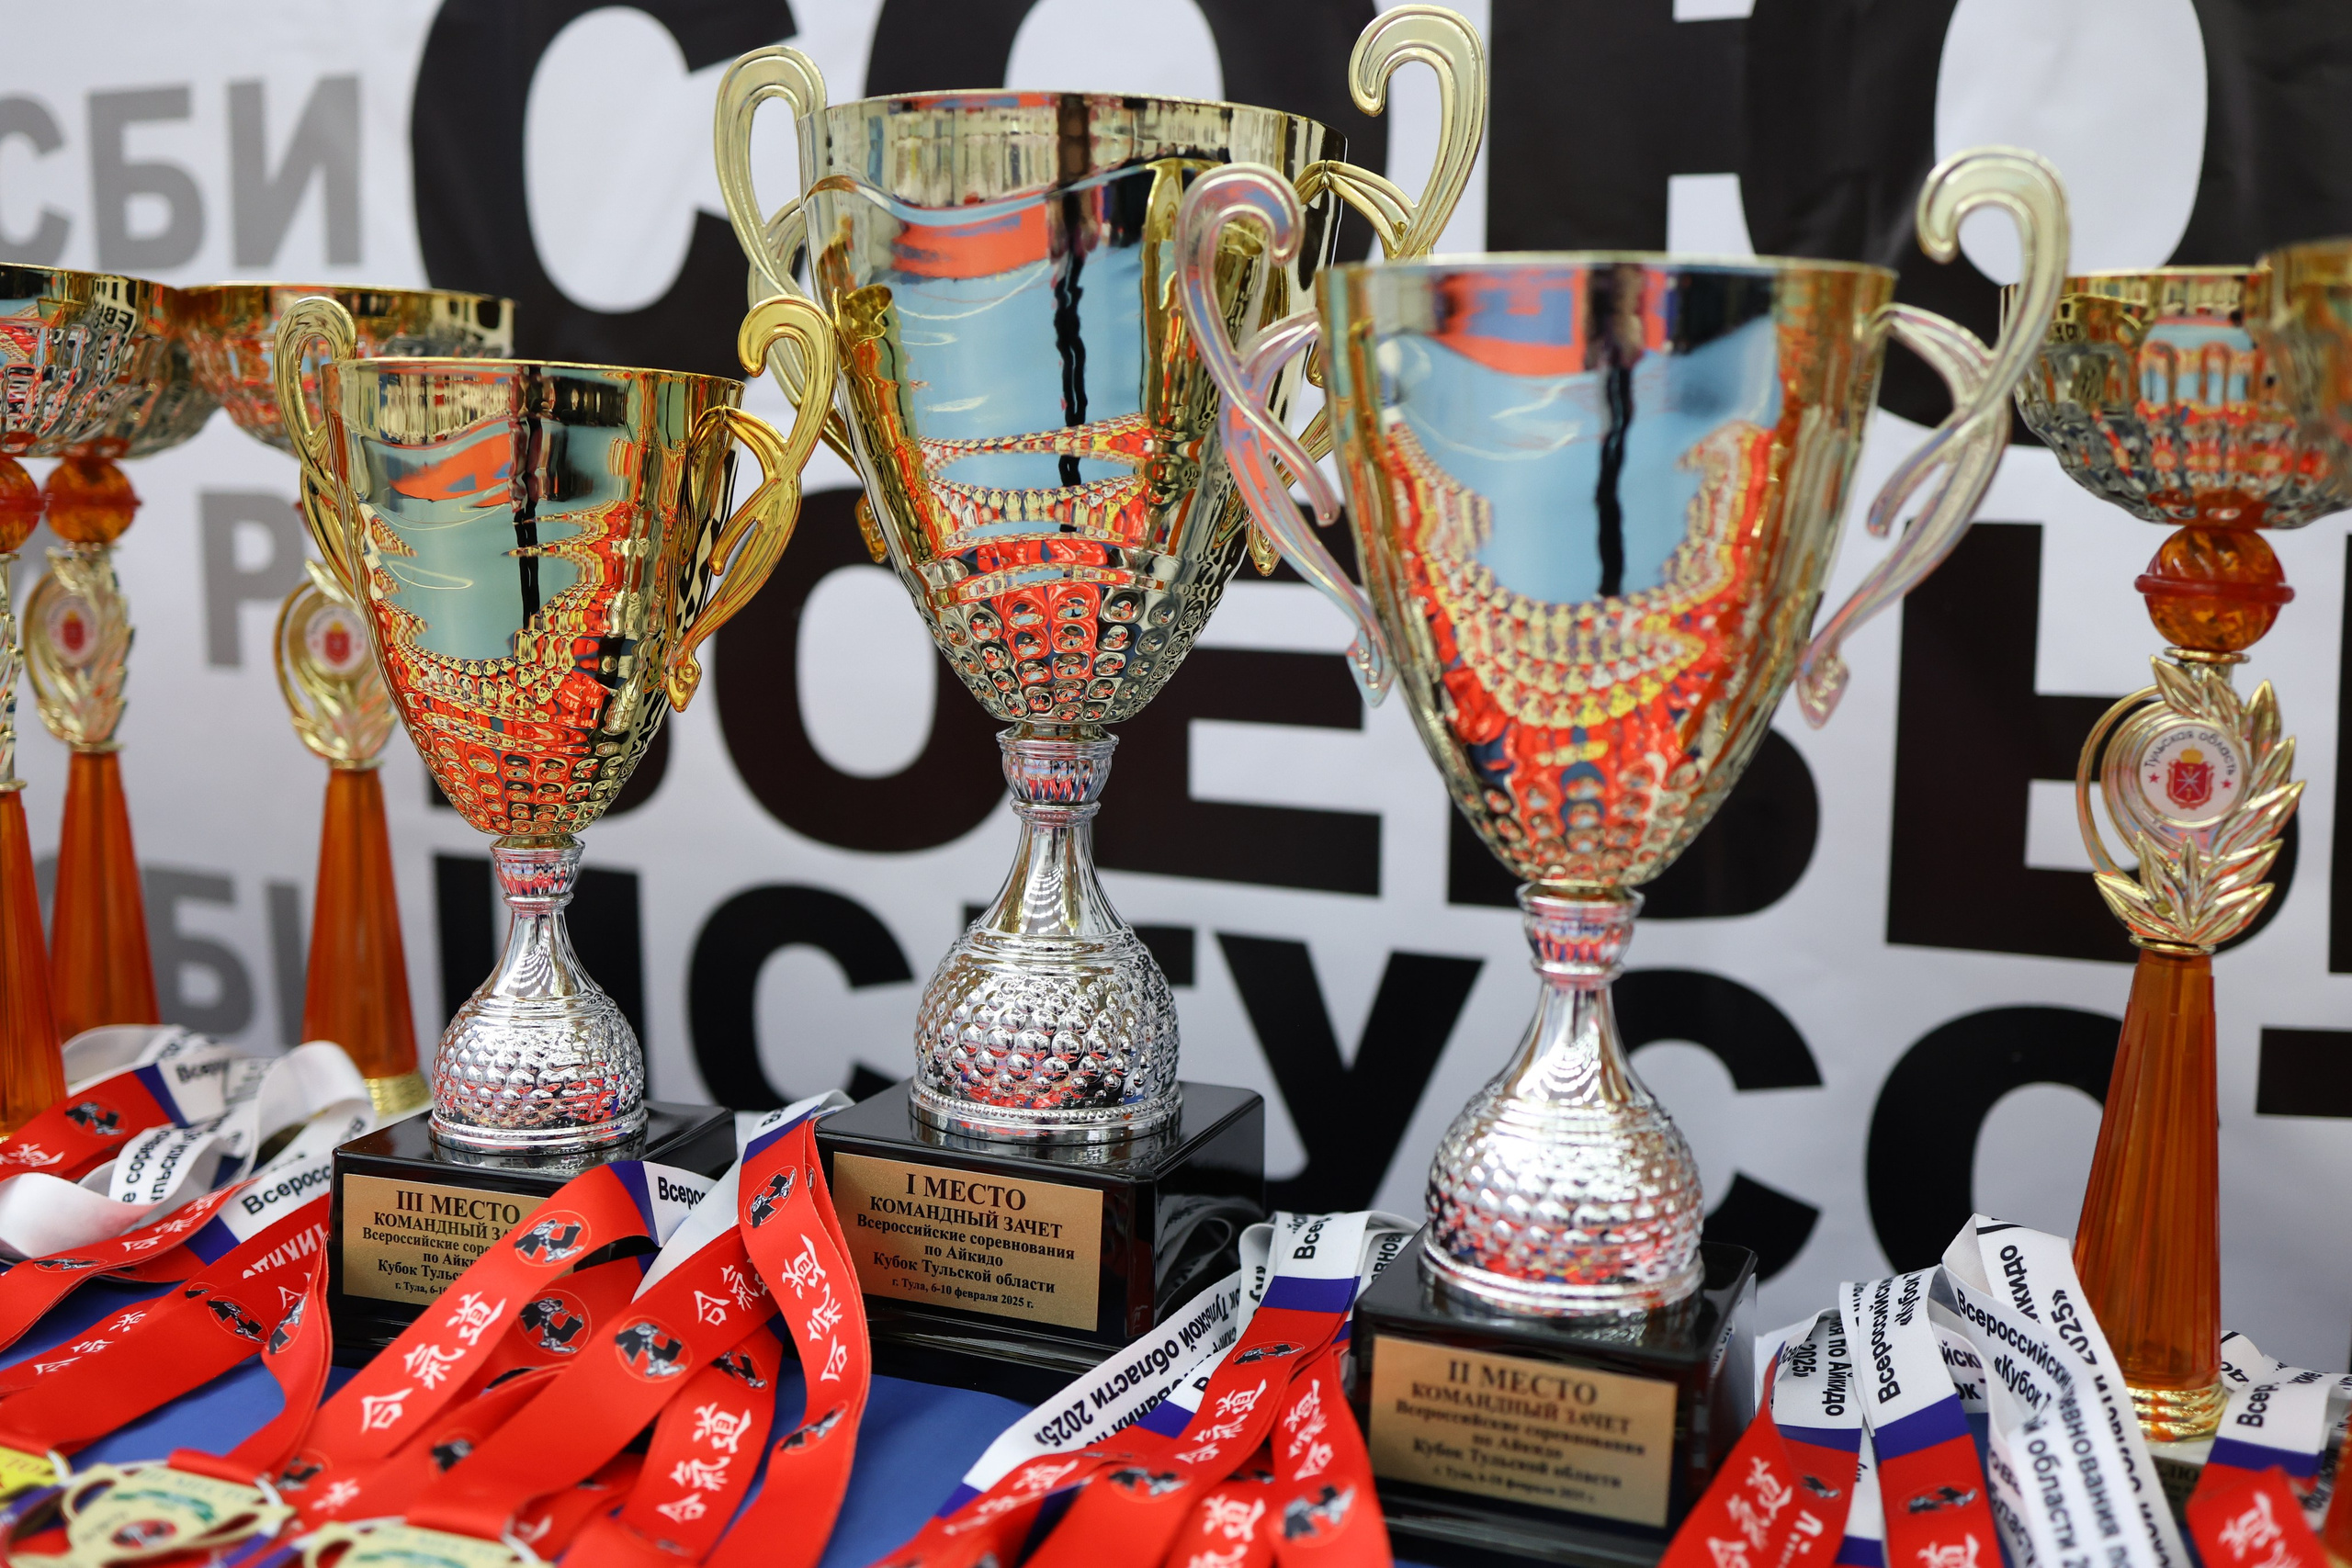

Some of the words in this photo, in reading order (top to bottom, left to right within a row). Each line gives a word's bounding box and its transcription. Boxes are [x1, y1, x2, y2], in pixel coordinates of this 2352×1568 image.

[2143, 729, 2194, 769] Тульская
[2199, 730, 2239, 776] область
[396, 1190, 424, 1213] III
[430, 1194, 520, 1224] МЕСТО
[906, 1173, 916, 1195] I
[923, 1176, 1026, 1211] МЕСТО
[373, 1212, 488, 1239] КОМАНДНЫЙ
[857, 1213, 966, 1243] Всероссийские
[970, 1233, 1075, 1259] соревнования
[870, 1196, 999, 1229] КОМАНДНЫЙ
[1003, 1216, 1063, 1239] ЗАЧЕТ
[363, 1227, 459, 1253] Всероссийские
[423, 1253, 438, 1263] по
[924, 1245, 942, 1257] по
[946, 1246, 1003, 1268] Айкидо
[378, 1259, 417, 1276] Кубок
[404, 1281, 427, 1294] Тула,
[873, 1251, 918, 1271] Кубок
[922, 1259, 991, 1283] Тульской
[996, 1273, 1056, 1293] области
[892, 1278, 899, 1286] г.
[901, 1279, 928, 1292] Тула,
[931, 1283, 952, 1295] 6-10
[955, 1287, 999, 1303] февраля
[1001, 1294, 1024, 1307] 2025
[1026, 1300, 1035, 1309] г.
[361, 1292, 506, 1433] 合氣道
[1827, 1338, 1847, 1357] по
[1090, 1339, 1180, 1410] области
[1448, 1359, 1470, 1383] II
[1480, 1364, 1597, 1406] МЕСТО
[1822, 1361, 1853, 1416] Айкидо
[1034, 1400, 1094, 1448] 2025»
[1410, 1382, 1559, 1420] КОМАНДНЫЙ
[1566, 1410, 1632, 1435] ЗАЧЕТ
[2028, 1438, 2076, 1551] области
